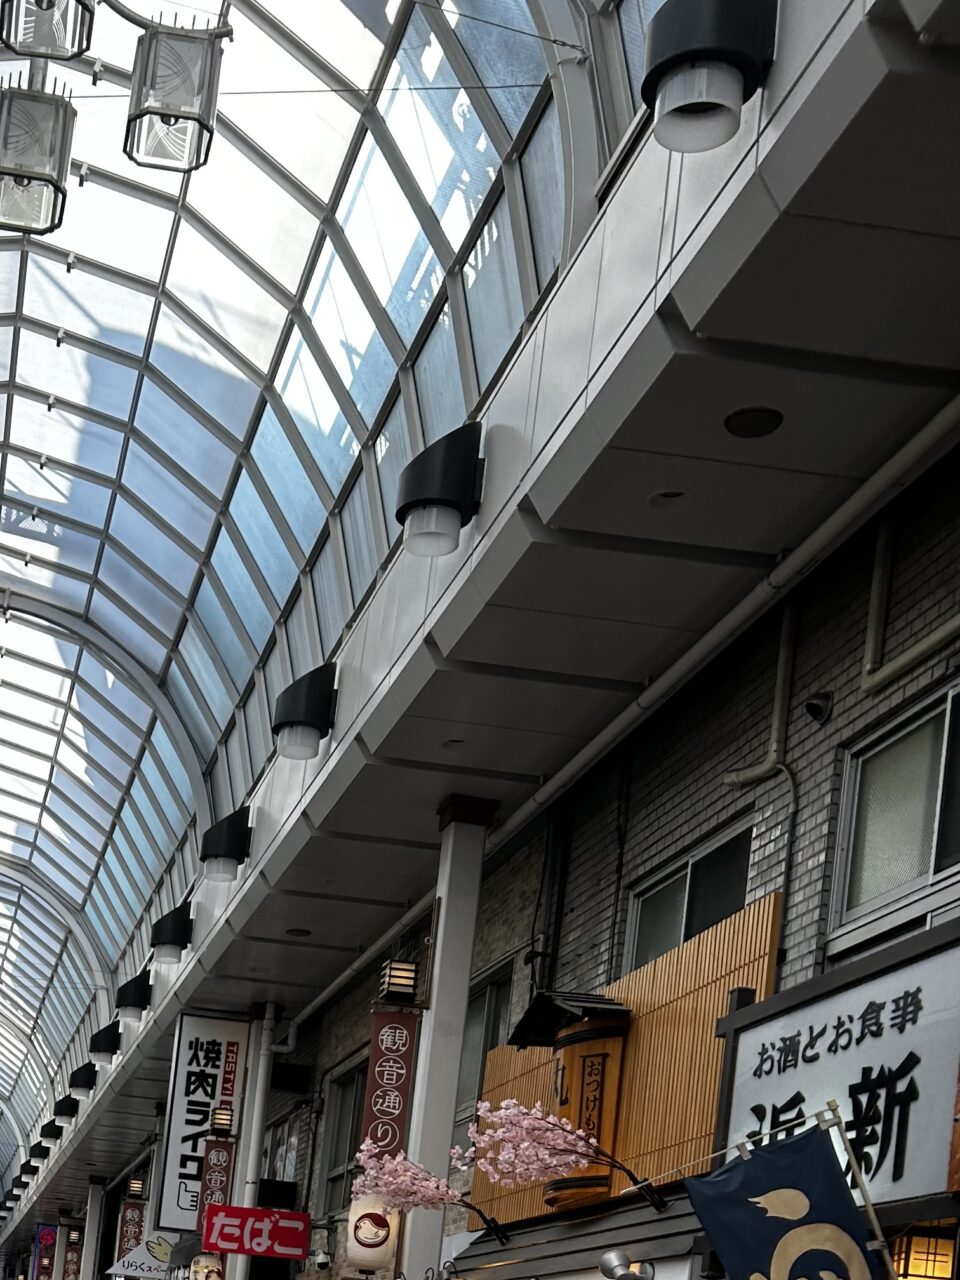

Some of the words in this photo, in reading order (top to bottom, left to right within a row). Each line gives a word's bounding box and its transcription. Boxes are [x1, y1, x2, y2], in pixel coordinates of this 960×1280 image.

[753, 986, 924, 1079] お酒とお食事
[367, 1023, 410, 1151] 観音通り
[203, 1148, 230, 1208] 観音通
[209, 1211, 304, 1255] たばこ
